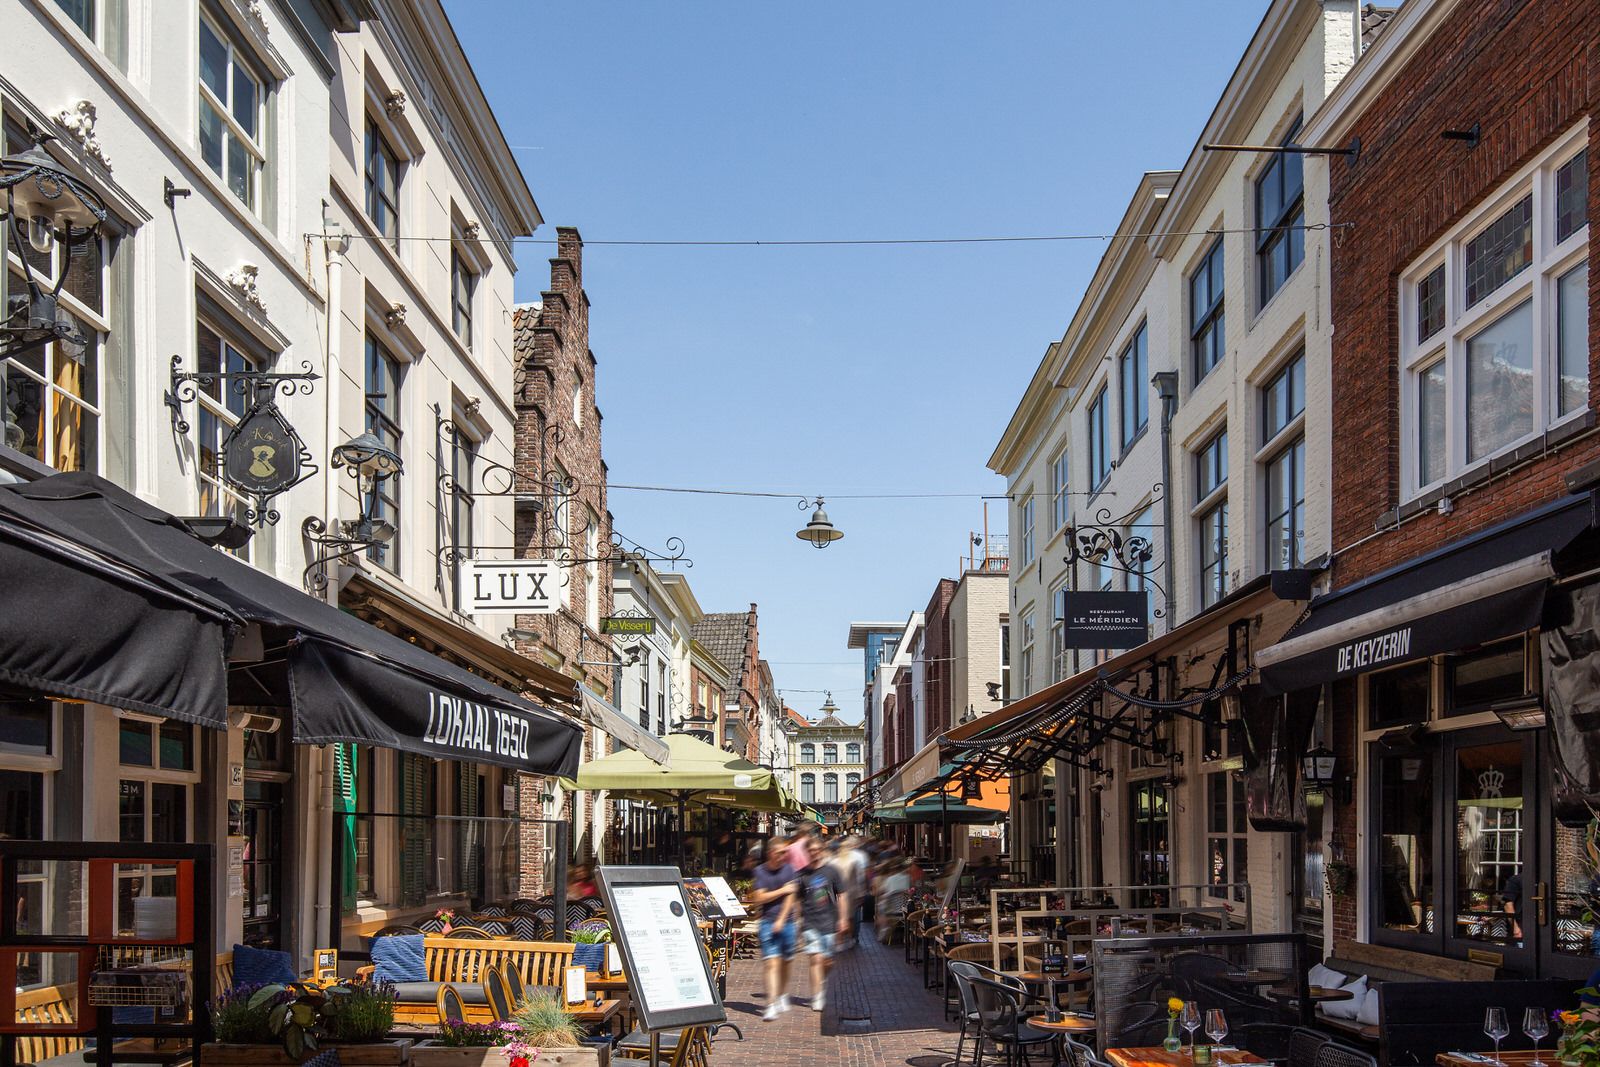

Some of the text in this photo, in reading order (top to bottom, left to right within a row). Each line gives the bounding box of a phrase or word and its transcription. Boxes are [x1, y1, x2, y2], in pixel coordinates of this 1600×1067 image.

[474, 573, 548, 600] LUX
[1089, 615, 1139, 624] MÉRIDIEN
[1337, 627, 1411, 673] DE KEYZERIN
[424, 692, 529, 760] LOKAAL 1650
